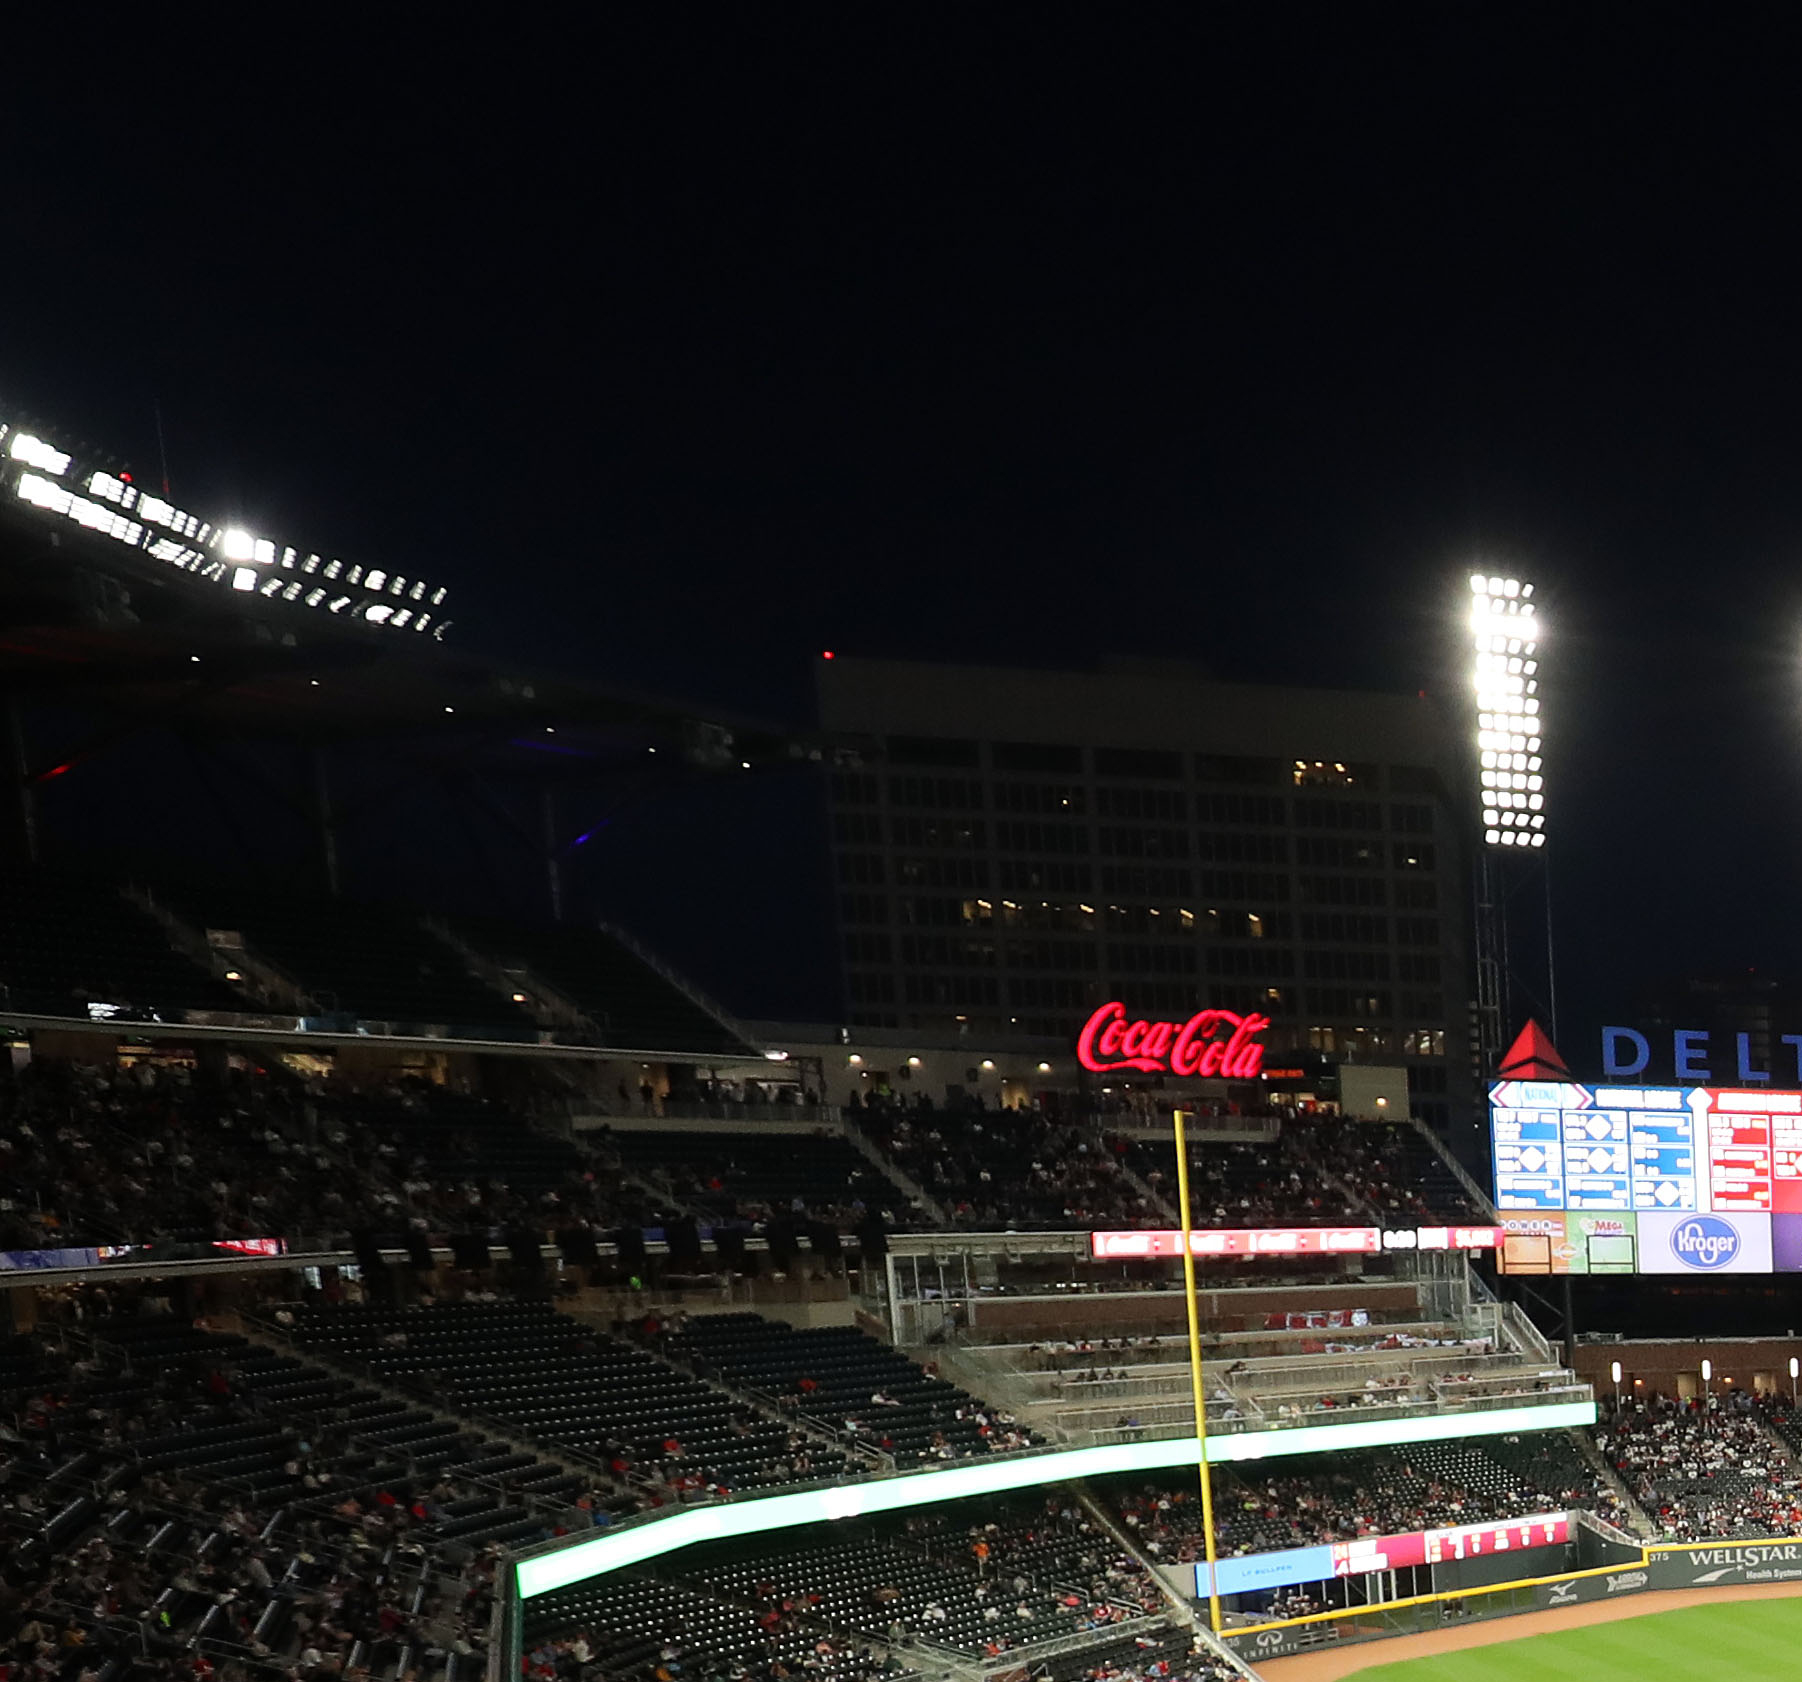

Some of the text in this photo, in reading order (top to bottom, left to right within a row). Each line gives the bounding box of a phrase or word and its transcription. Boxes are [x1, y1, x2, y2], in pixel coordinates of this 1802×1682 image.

[1078, 1002, 1271, 1078] Coca-Cola
[1677, 1222, 1735, 1264] Kroger
[1649, 1551, 1669, 1562] 375
[1689, 1545, 1798, 1567] WELLSTAR
[1746, 1567, 1802, 1580] Health System
